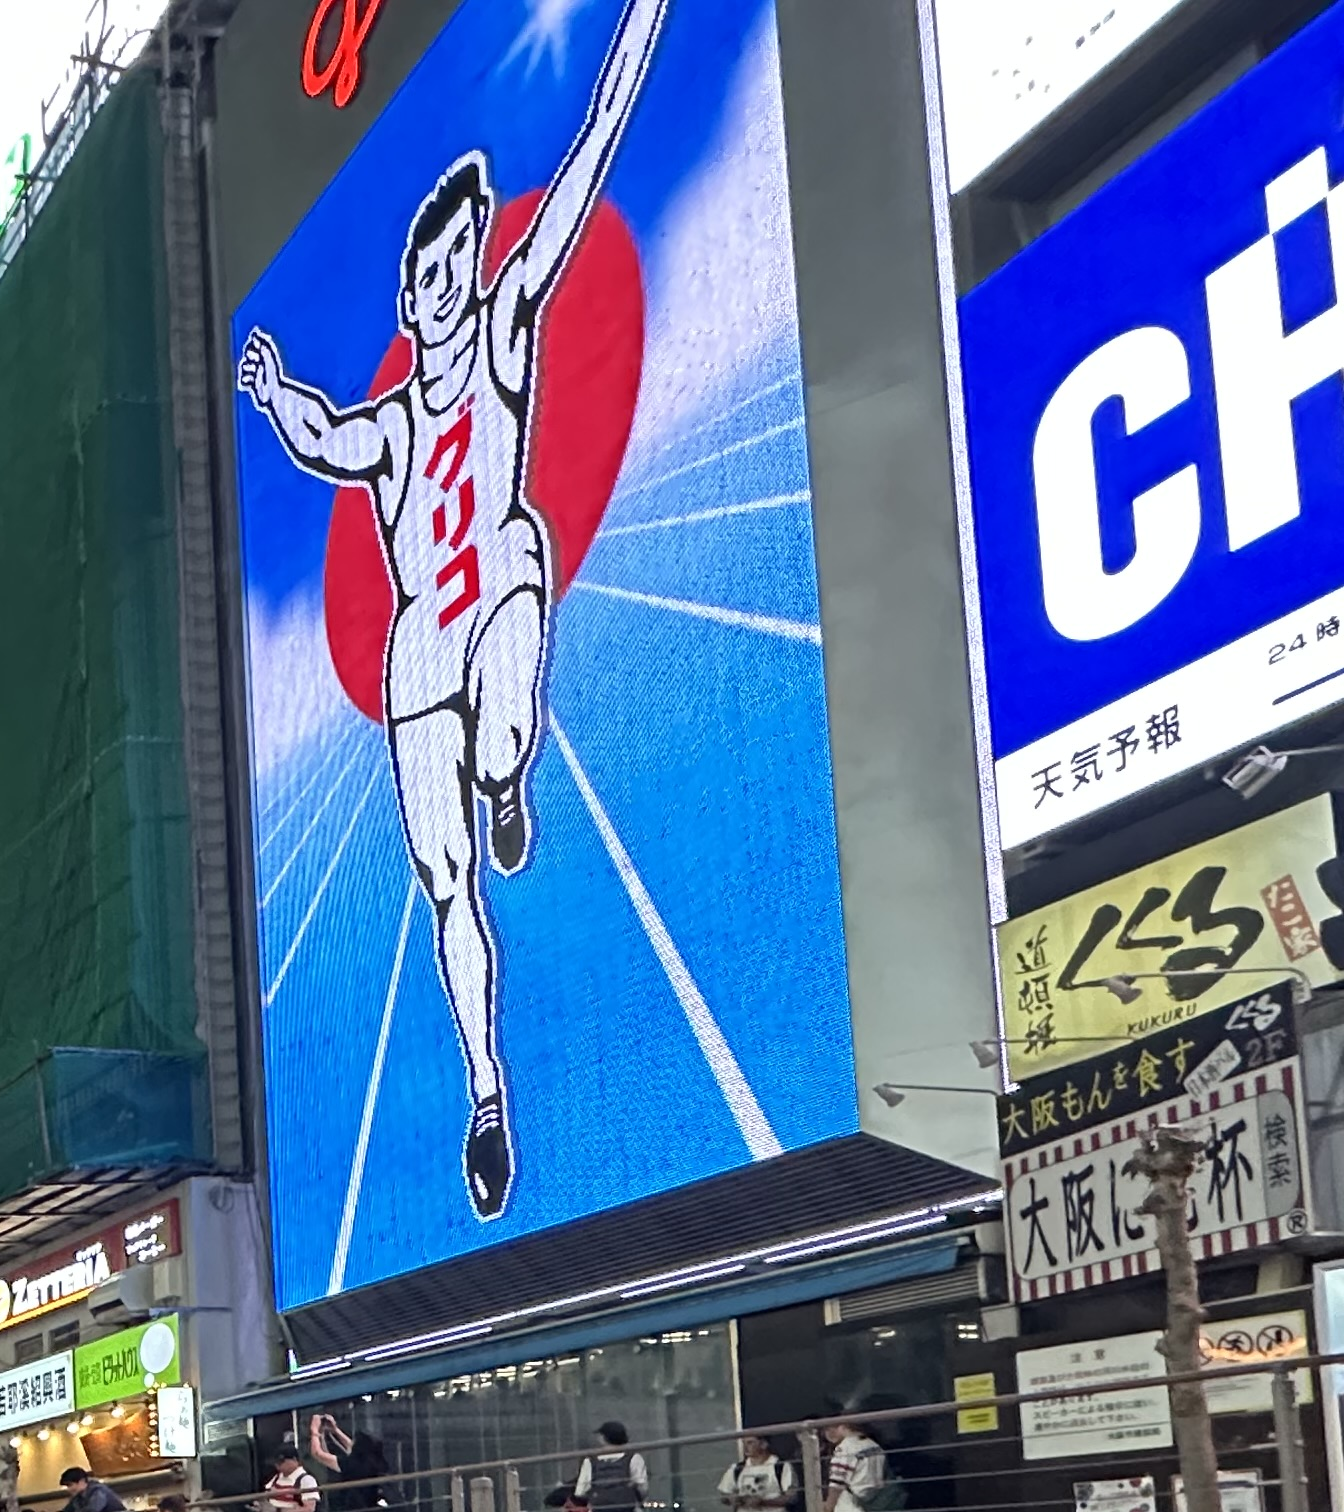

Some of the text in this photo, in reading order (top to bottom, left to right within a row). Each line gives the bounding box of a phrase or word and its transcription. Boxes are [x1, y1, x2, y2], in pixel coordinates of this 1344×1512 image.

[422, 393, 481, 632] グリコ
[1030, 704, 1182, 809] 天気予報
[1125, 1002, 1198, 1036] KUKURU
[1001, 1038, 1196, 1144] 大阪もんを食す
[1019, 1116, 1254, 1274] 大阪に杯
[1263, 1113, 1292, 1189] 検索
[12, 1252, 112, 1319] ZETTERIA
